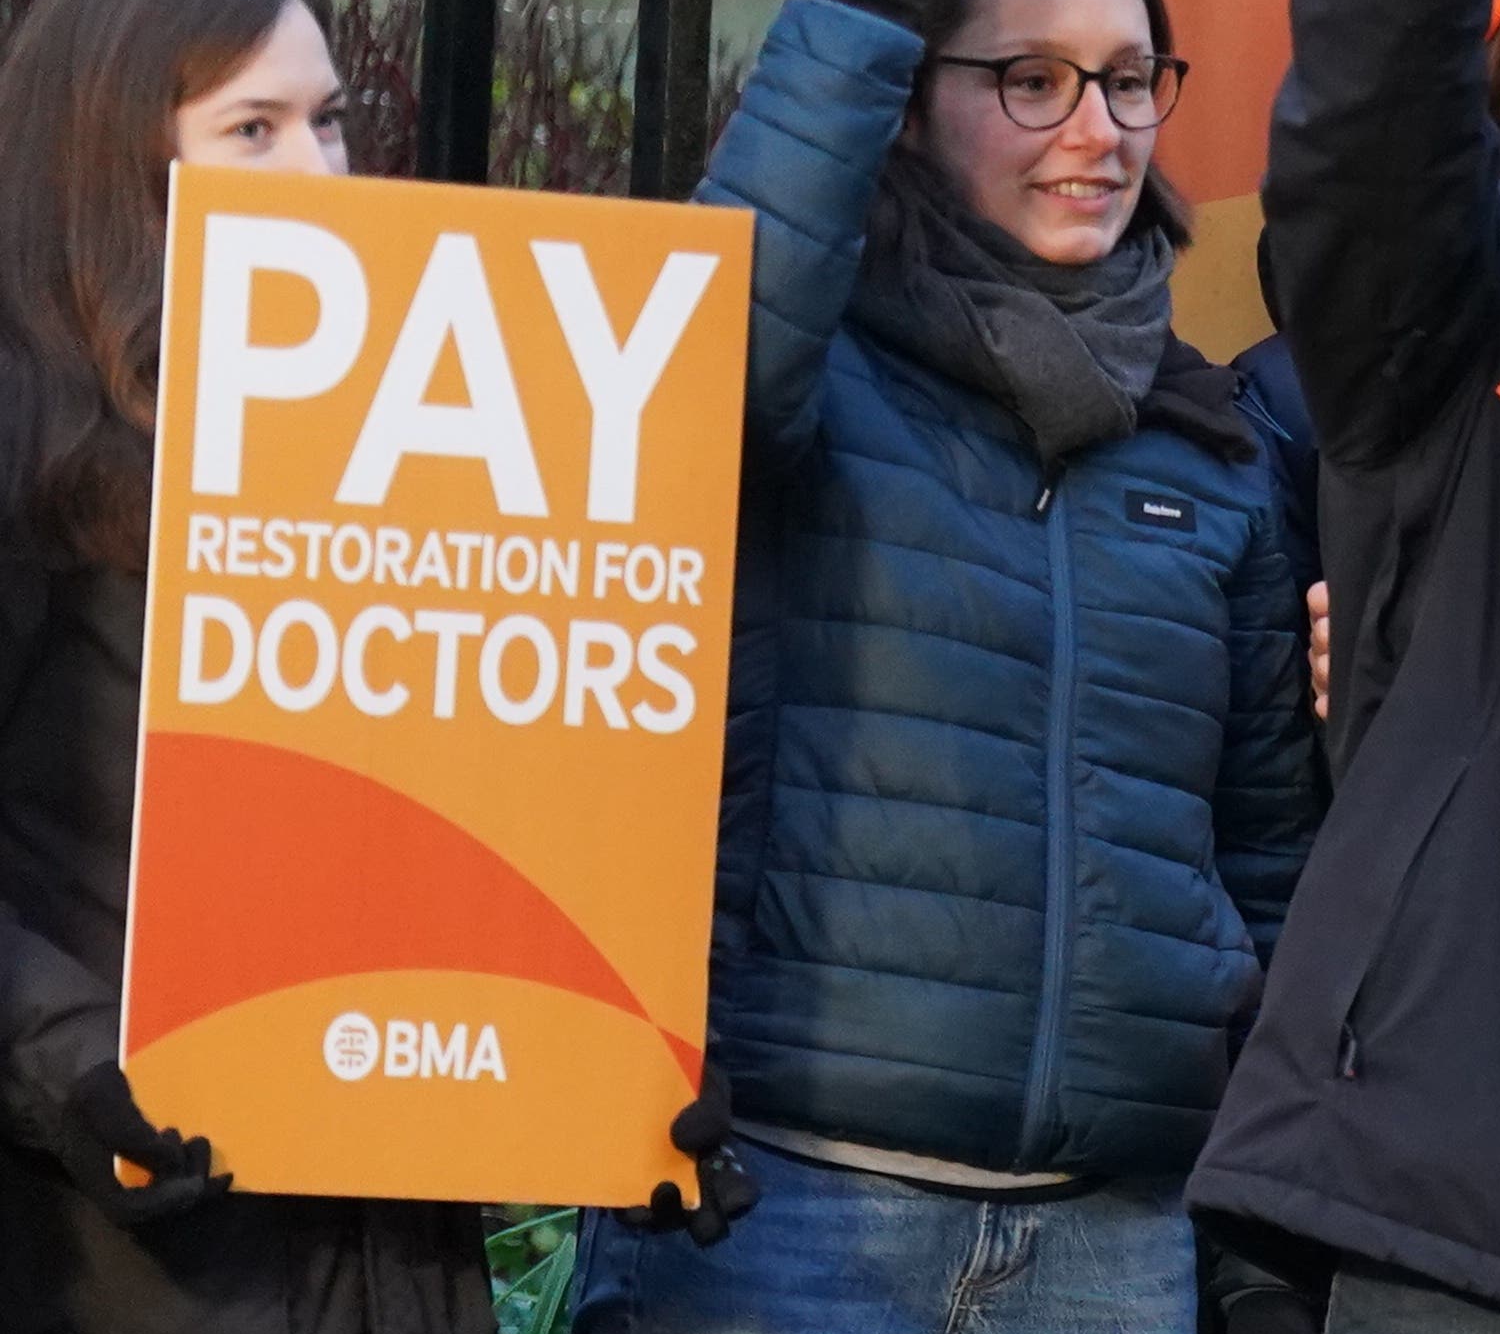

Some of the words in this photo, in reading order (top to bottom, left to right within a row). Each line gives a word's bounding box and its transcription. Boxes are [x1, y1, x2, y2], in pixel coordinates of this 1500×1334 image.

[191, 213, 722, 524] PAY
[186, 513, 579, 599] RESTORATION
[596, 541, 703, 607] FOR
[177, 594, 697, 735] DOCTORS
[383, 1019, 507, 1083] BMA
